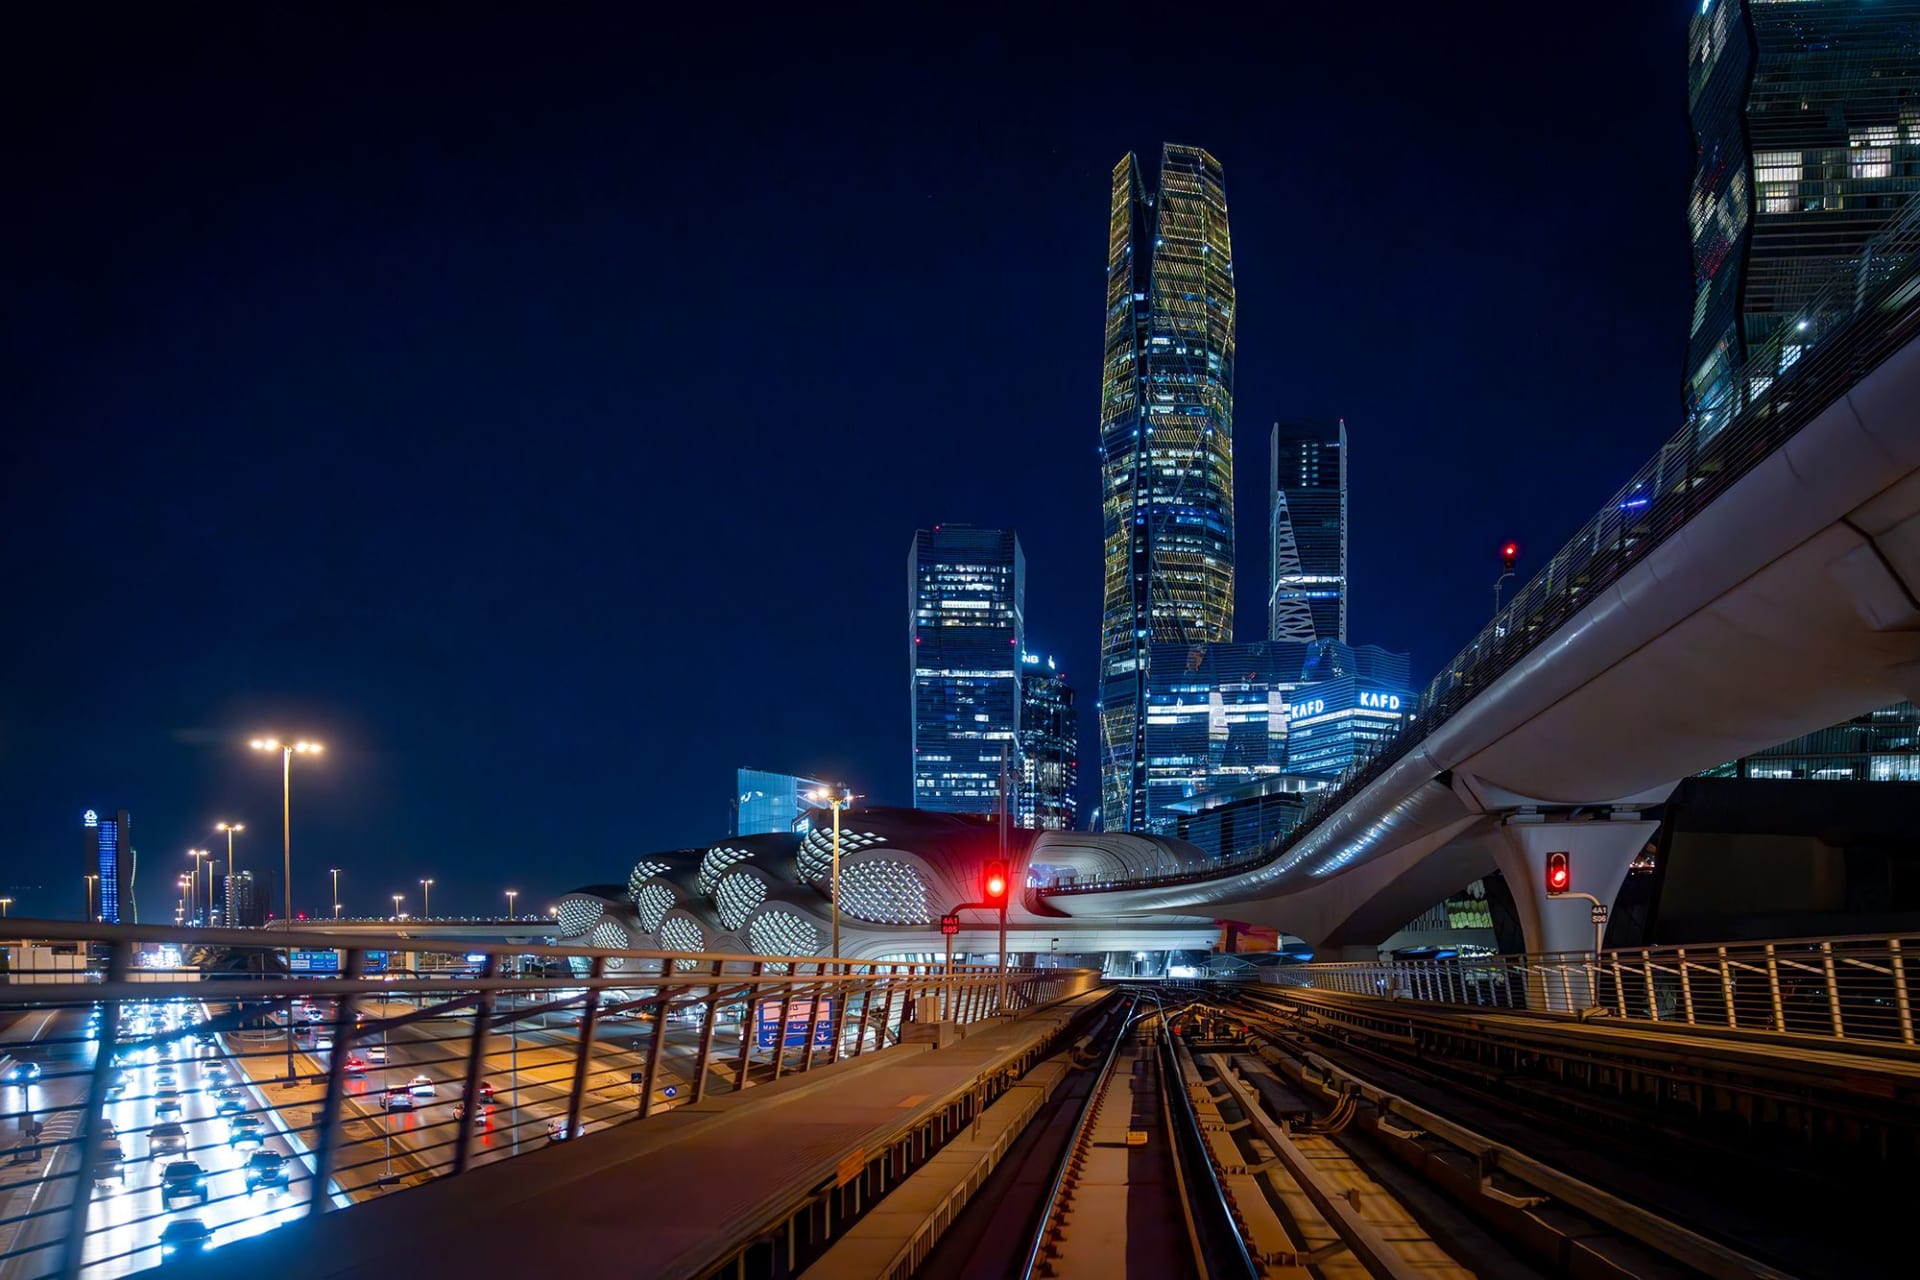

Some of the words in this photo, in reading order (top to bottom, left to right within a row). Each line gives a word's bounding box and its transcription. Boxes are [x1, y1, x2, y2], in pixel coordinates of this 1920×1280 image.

[1360, 692, 1399, 709] KAFD
[1292, 700, 1324, 718] KAFD
[1592, 906, 1607, 914] 4A1
[943, 917, 958, 925] 4A1
